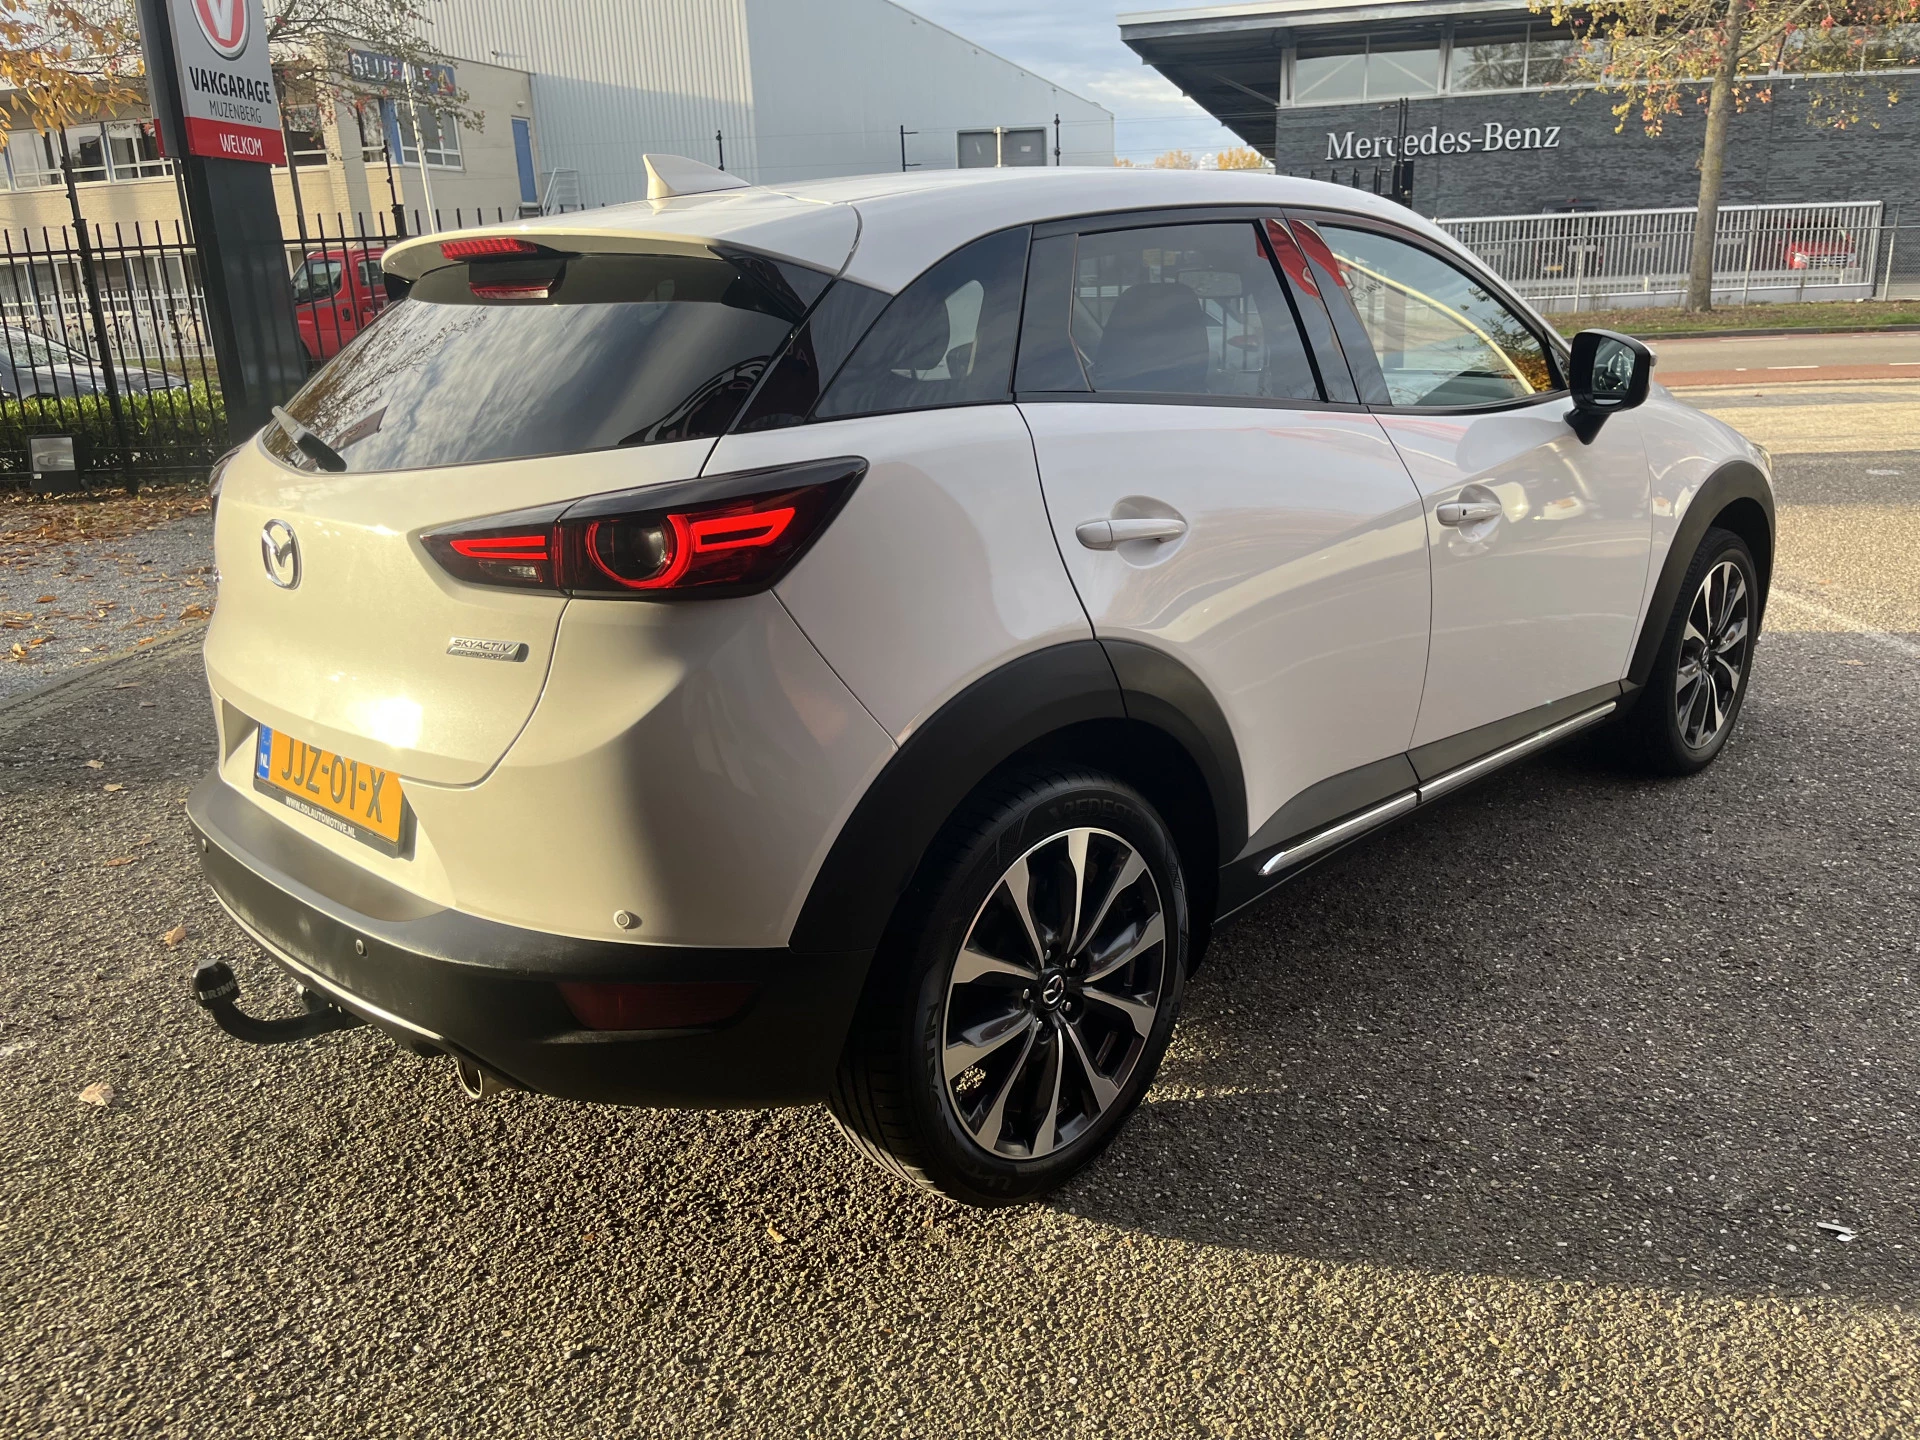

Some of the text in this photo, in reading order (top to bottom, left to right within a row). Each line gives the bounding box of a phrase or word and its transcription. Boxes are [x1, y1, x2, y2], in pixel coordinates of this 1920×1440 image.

[188, 66, 272, 104] VAKGARAGE
[209, 100, 262, 124] MUZENBERG
[219, 133, 263, 156] WELKOM
[1325, 122, 1561, 160] Mercedes-Benz
[453, 639, 513, 652] SKYACTIV
[260, 752, 269, 769] NL
[282, 737, 386, 823] JJZ-01-X
